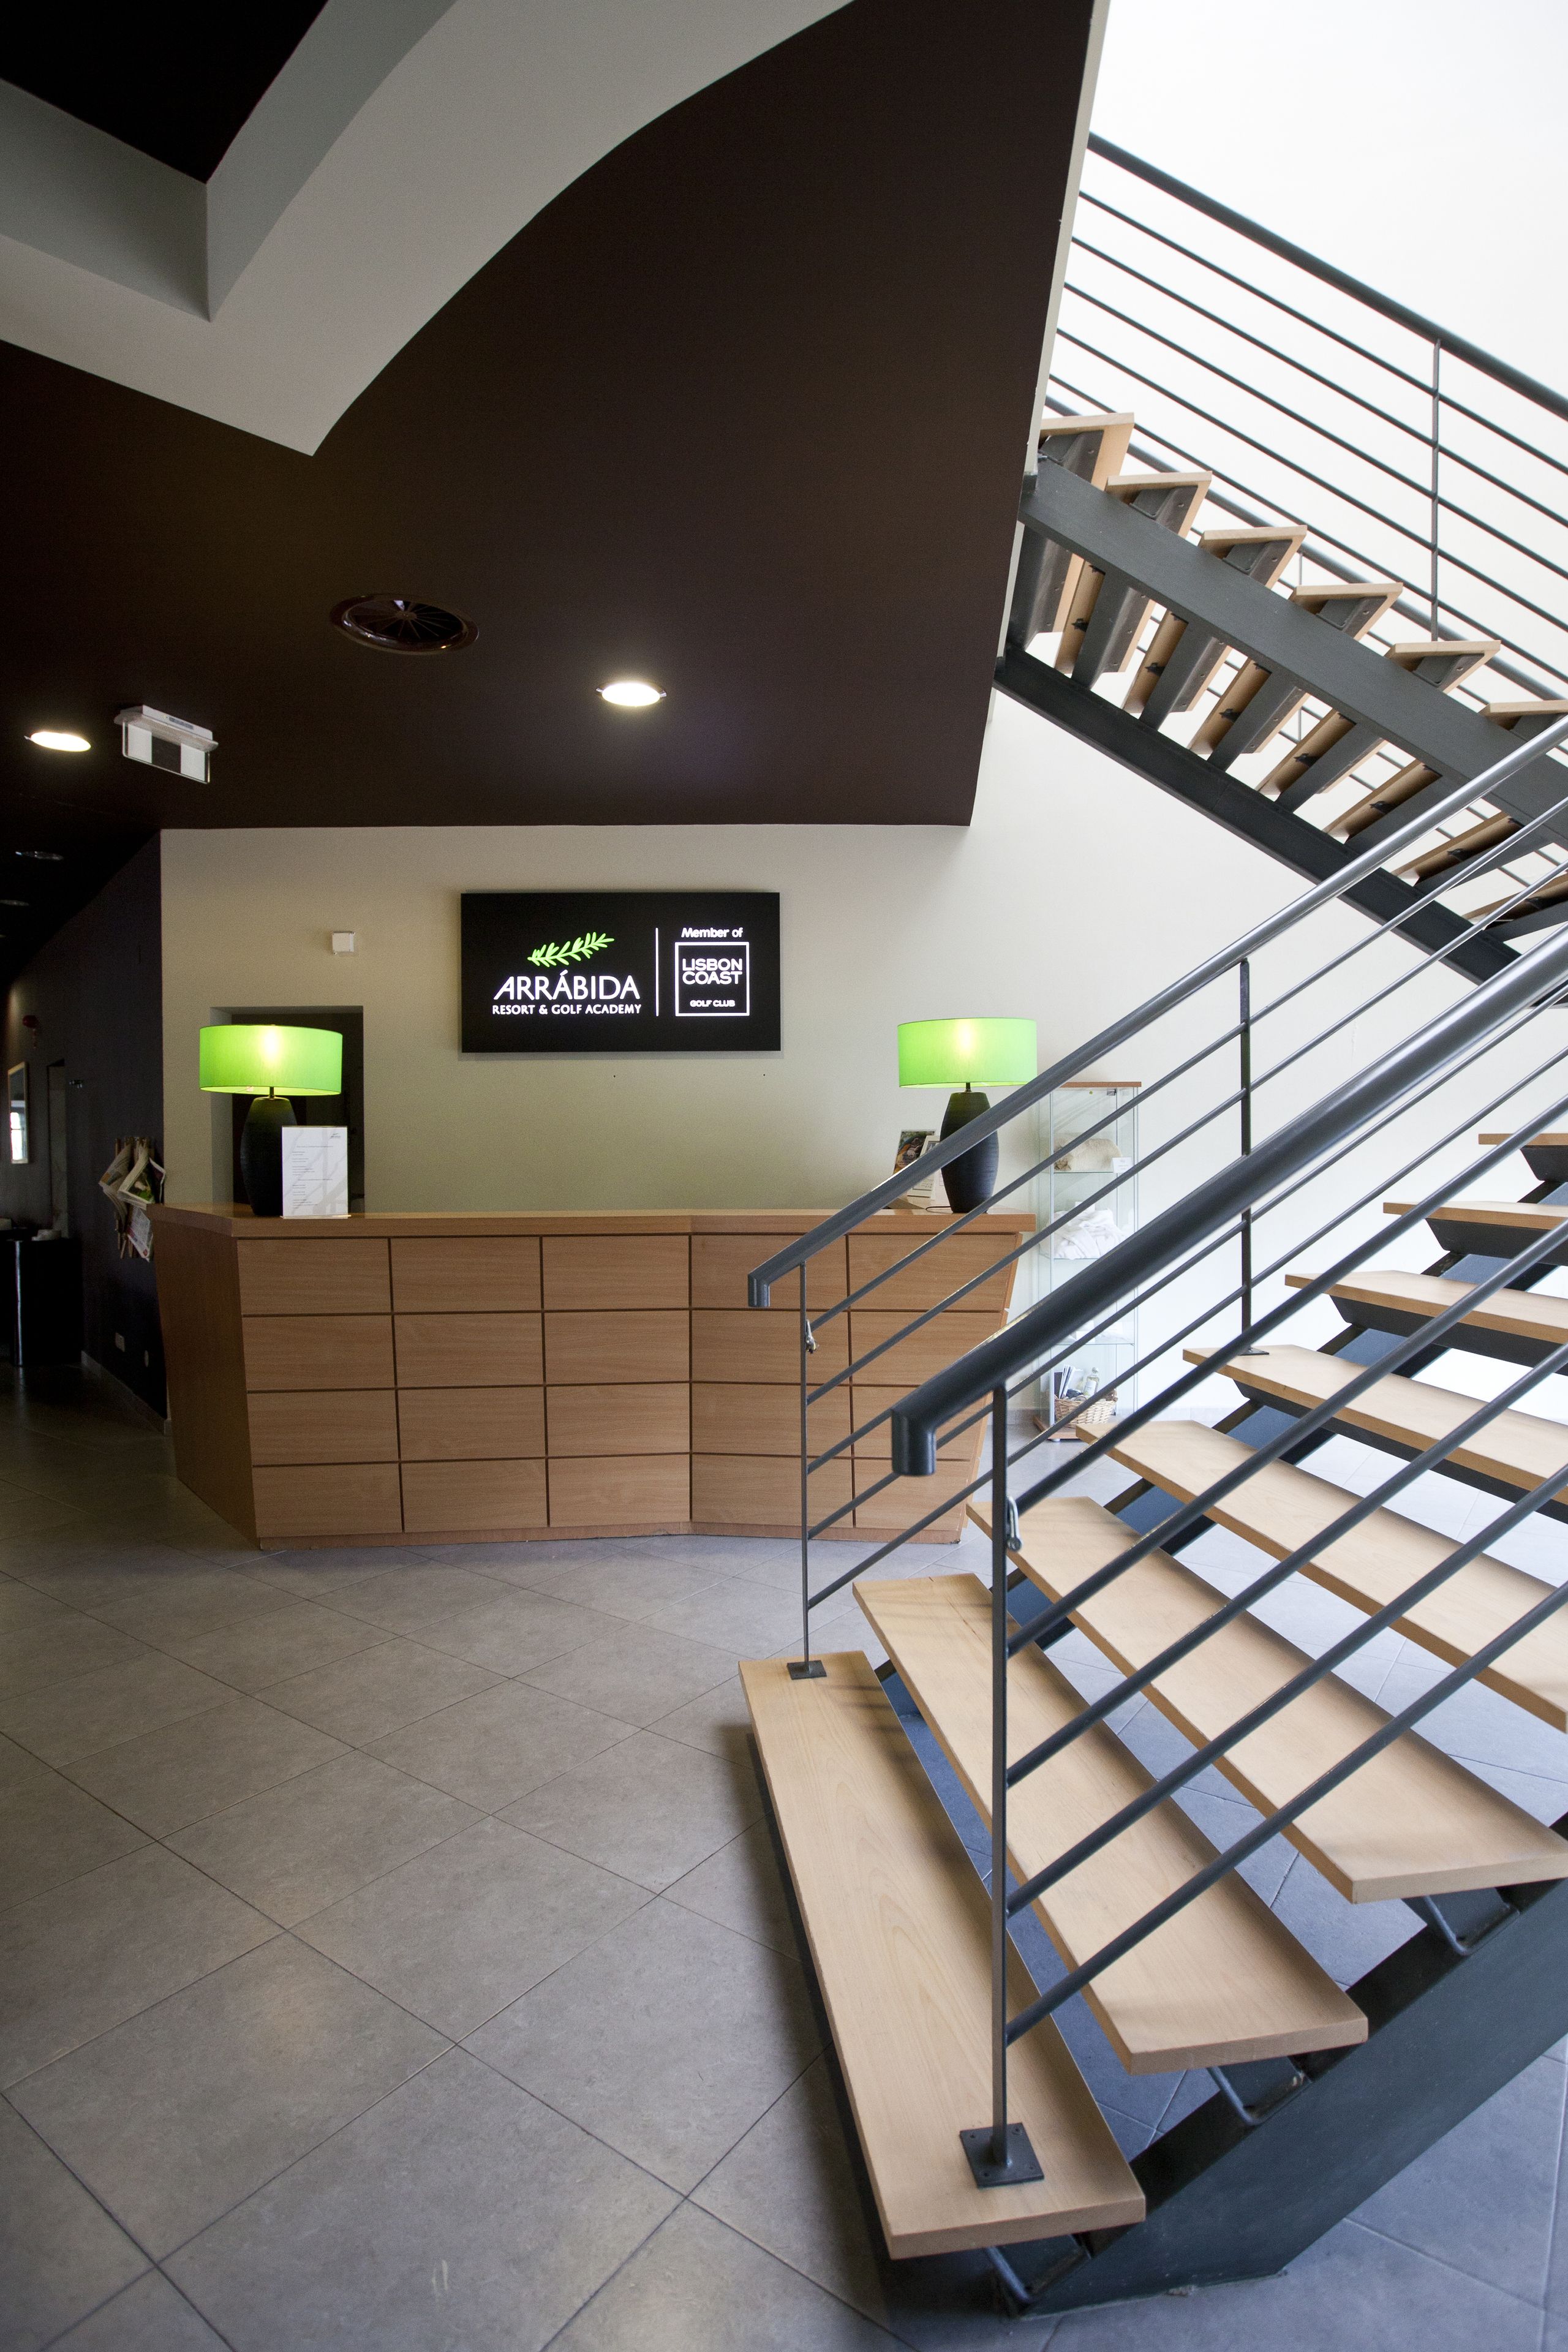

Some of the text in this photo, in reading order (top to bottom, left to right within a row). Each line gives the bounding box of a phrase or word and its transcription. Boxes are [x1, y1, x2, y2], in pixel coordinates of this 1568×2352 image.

[681, 927, 743, 938] Member of
[682, 958, 742, 971] LISBON
[682, 971, 742, 985] COAST
[493, 970, 640, 1000] ARRÁBIDA
[492, 1003, 641, 1015] RESORT & GOLF ACADEMY
